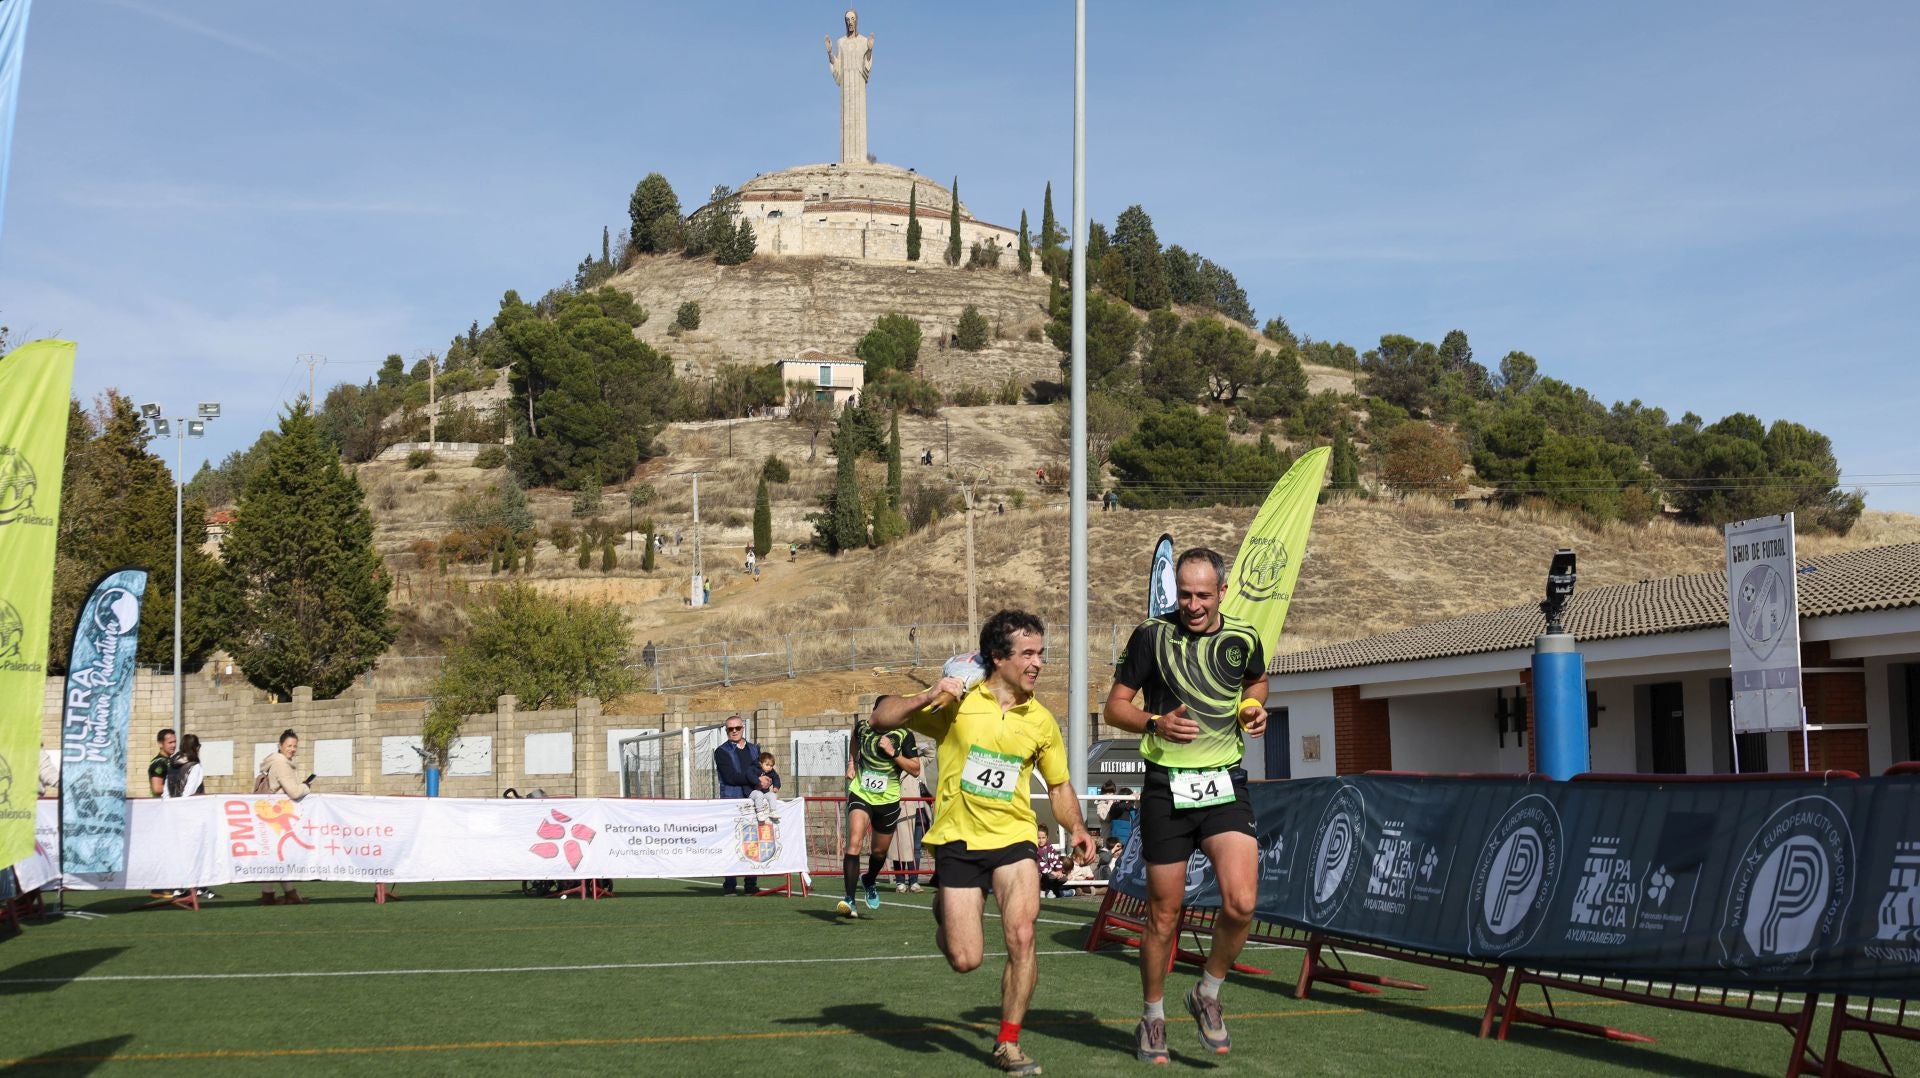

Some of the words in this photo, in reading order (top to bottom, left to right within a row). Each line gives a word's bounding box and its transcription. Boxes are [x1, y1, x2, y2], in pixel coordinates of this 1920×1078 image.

[1751, 542, 1761, 560] DE
[1762, 538, 1786, 559] FUTBOL
[89, 619, 120, 688] Palentina
[1778, 671, 1786, 685] V
[63, 667, 95, 763] ULTRA
[1100, 761, 1136, 773] ATLETISMO
[865, 778, 884, 790] 162
[976, 768, 1006, 789] 43
[1189, 779, 1220, 801] 54
[0, 807, 31, 819] alencia
[1813, 813, 1833, 834] CITY
[224, 800, 258, 858] PMD
[604, 823, 661, 833] Patronato
[663, 823, 718, 834] Municipal
[1763, 811, 1814, 849] EUROPEAN
[1829, 829, 1841, 848] OF
[628, 836, 642, 845] de
[645, 836, 698, 846] Deportes
[1397, 840, 1412, 859] PA
[1501, 807, 1535, 837] EUROPEAN
[1534, 808, 1547, 826] CITY
[1547, 838, 1556, 877] SPORT
[608, 848, 670, 858] Ayuntamiento
[671, 847, 683, 856] de
[685, 846, 723, 855] Palencia
[234, 864, 285, 875] Patronato
[333, 864, 346, 875] de
[348, 866, 394, 876] Deportes
[1392, 859, 1416, 879] LEN
[1612, 859, 1631, 881] PA
[1834, 847, 1845, 895] SPORT
[1388, 878, 1406, 899] CIA
[1605, 881, 1636, 905] LEN
[1730, 862, 1757, 928] PALENCIA
[1363, 898, 1406, 915] AYUNTAMIENTO
[1601, 904, 1626, 928] CIA
[1822, 898, 1841, 934] 2026
[1564, 928, 1627, 945] AYUNTAMIENTO
[1863, 945, 1920, 964] AYUNTA
